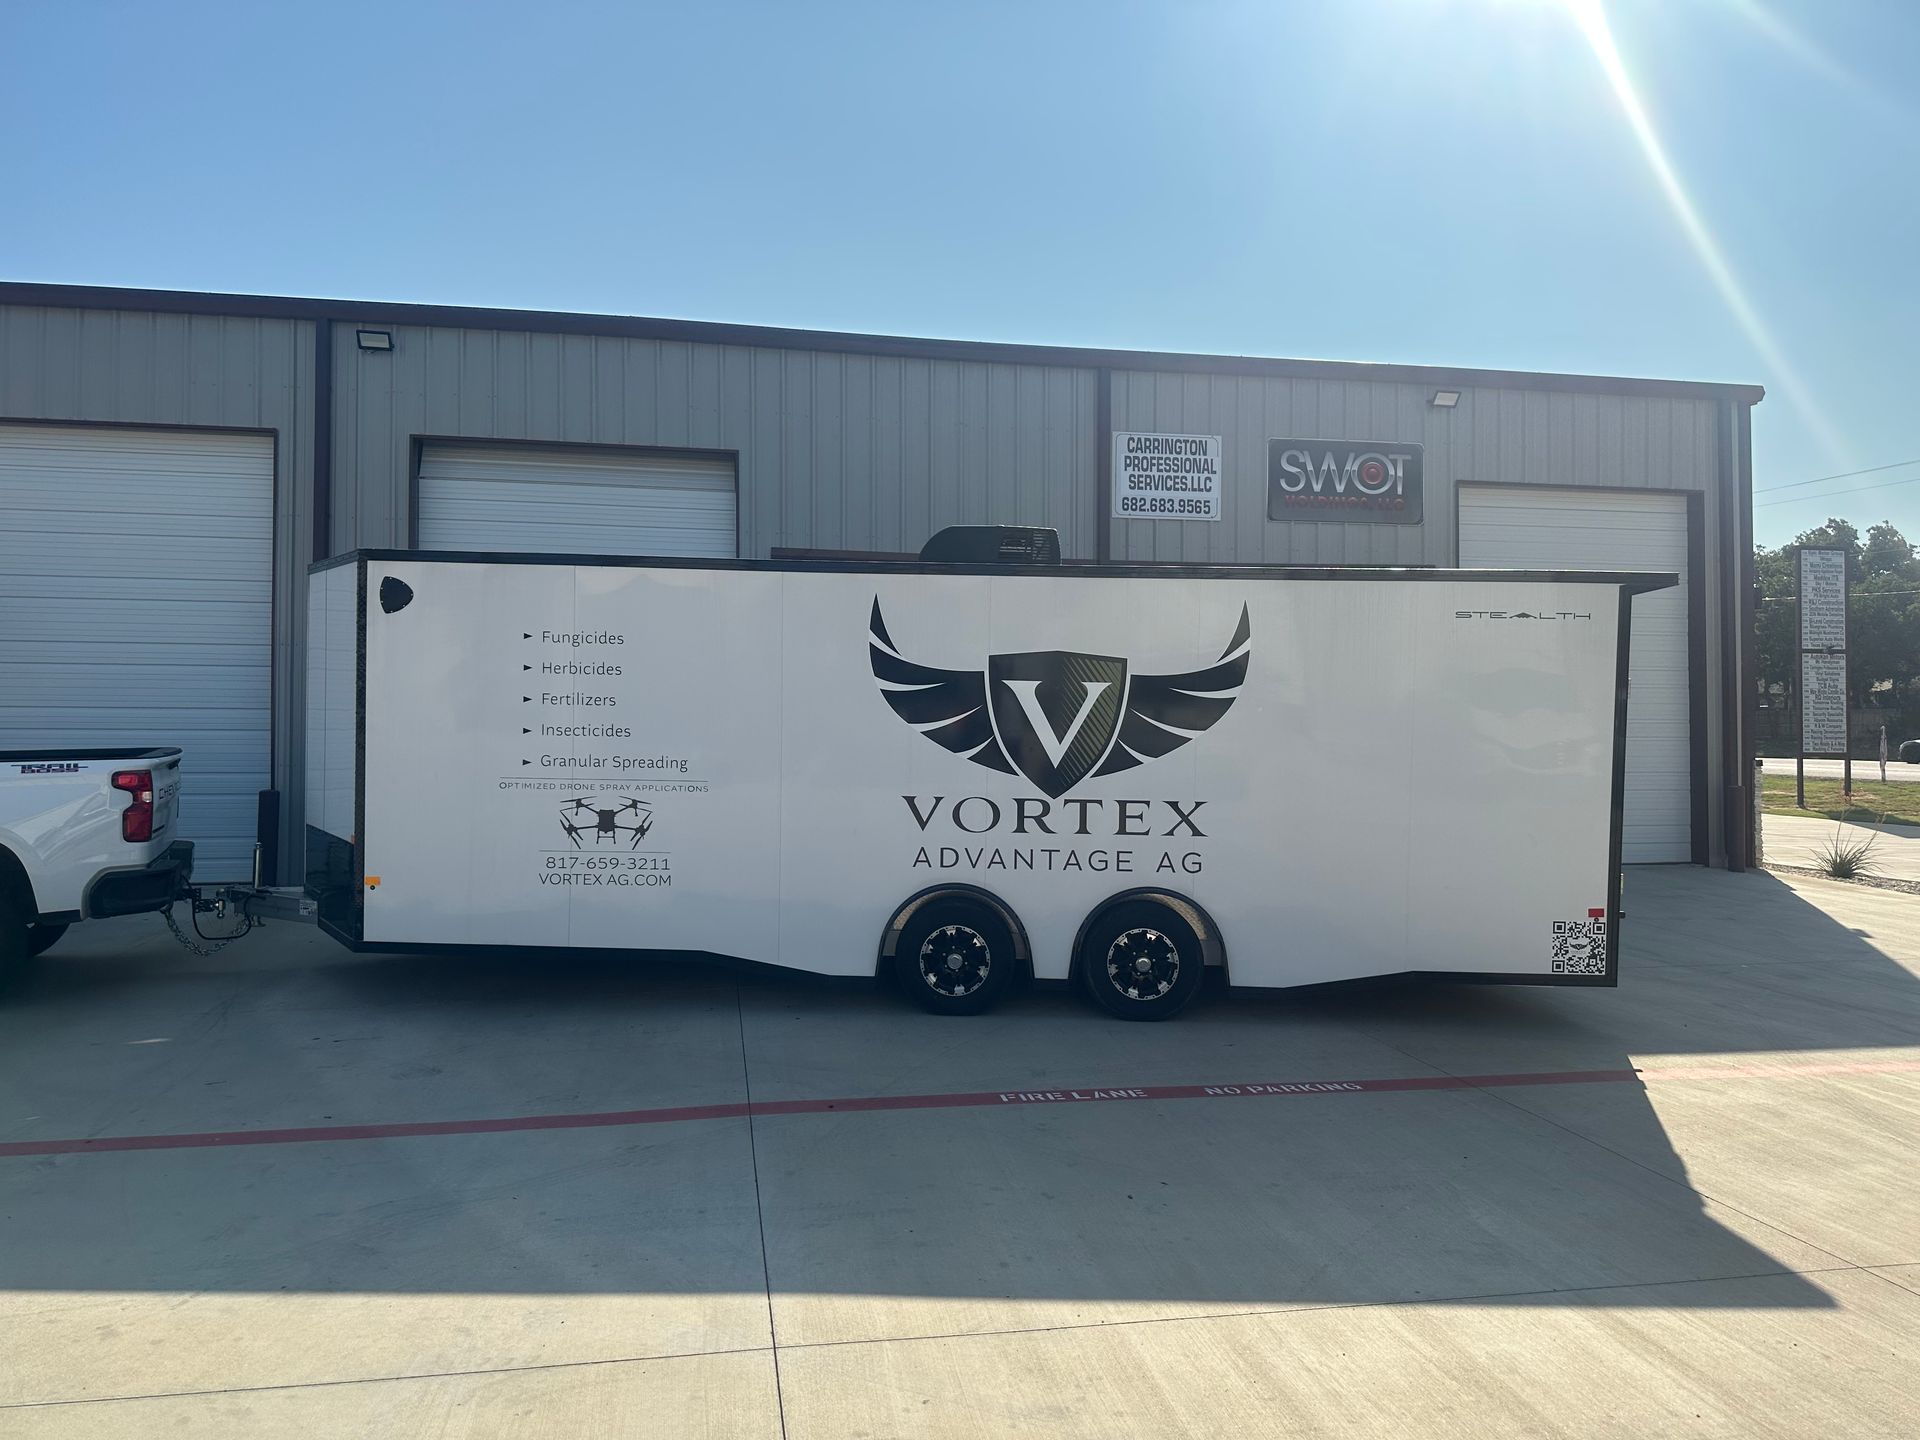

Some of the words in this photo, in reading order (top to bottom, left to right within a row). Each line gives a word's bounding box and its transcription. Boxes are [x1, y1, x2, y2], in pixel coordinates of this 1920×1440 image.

[1127, 436, 1208, 457] CARRINGTON
[1124, 455, 1217, 475] PROFESSIONAL
[1279, 450, 1411, 495] SWOT
[1128, 474, 1212, 493] SERVICES.LLC
[1121, 496, 1211, 515] 682.683.9565
[1455, 611, 1591, 620] STEALTH
[541, 631, 625, 647] Fungicides
[541, 661, 623, 676] Herbicides
[541, 692, 617, 706] Fertilizers
[541, 723, 631, 738] Insecticides
[1002, 679, 1112, 769] V
[540, 754, 608, 768] Granular
[612, 755, 688, 773] Spreading
[499, 781, 556, 790] OPTIMIZED
[559, 783, 596, 791] DRONE
[599, 784, 631, 792] SPRAY
[634, 784, 709, 793] APPLICATIONS
[901, 795, 1208, 837] VORTEX
[545, 856, 671, 871] 817-659-3211
[912, 846, 1134, 872] ADVANTAGE
[1156, 851, 1203, 874] AG
[538, 873, 602, 886] VORTEX
[606, 874, 672, 887] AG.COM
[999, 1091, 1066, 1102] FIRE
[1071, 1089, 1148, 1101] LANE
[1203, 1085, 1241, 1096] NO
[1245, 1082, 1364, 1095] PARKING
